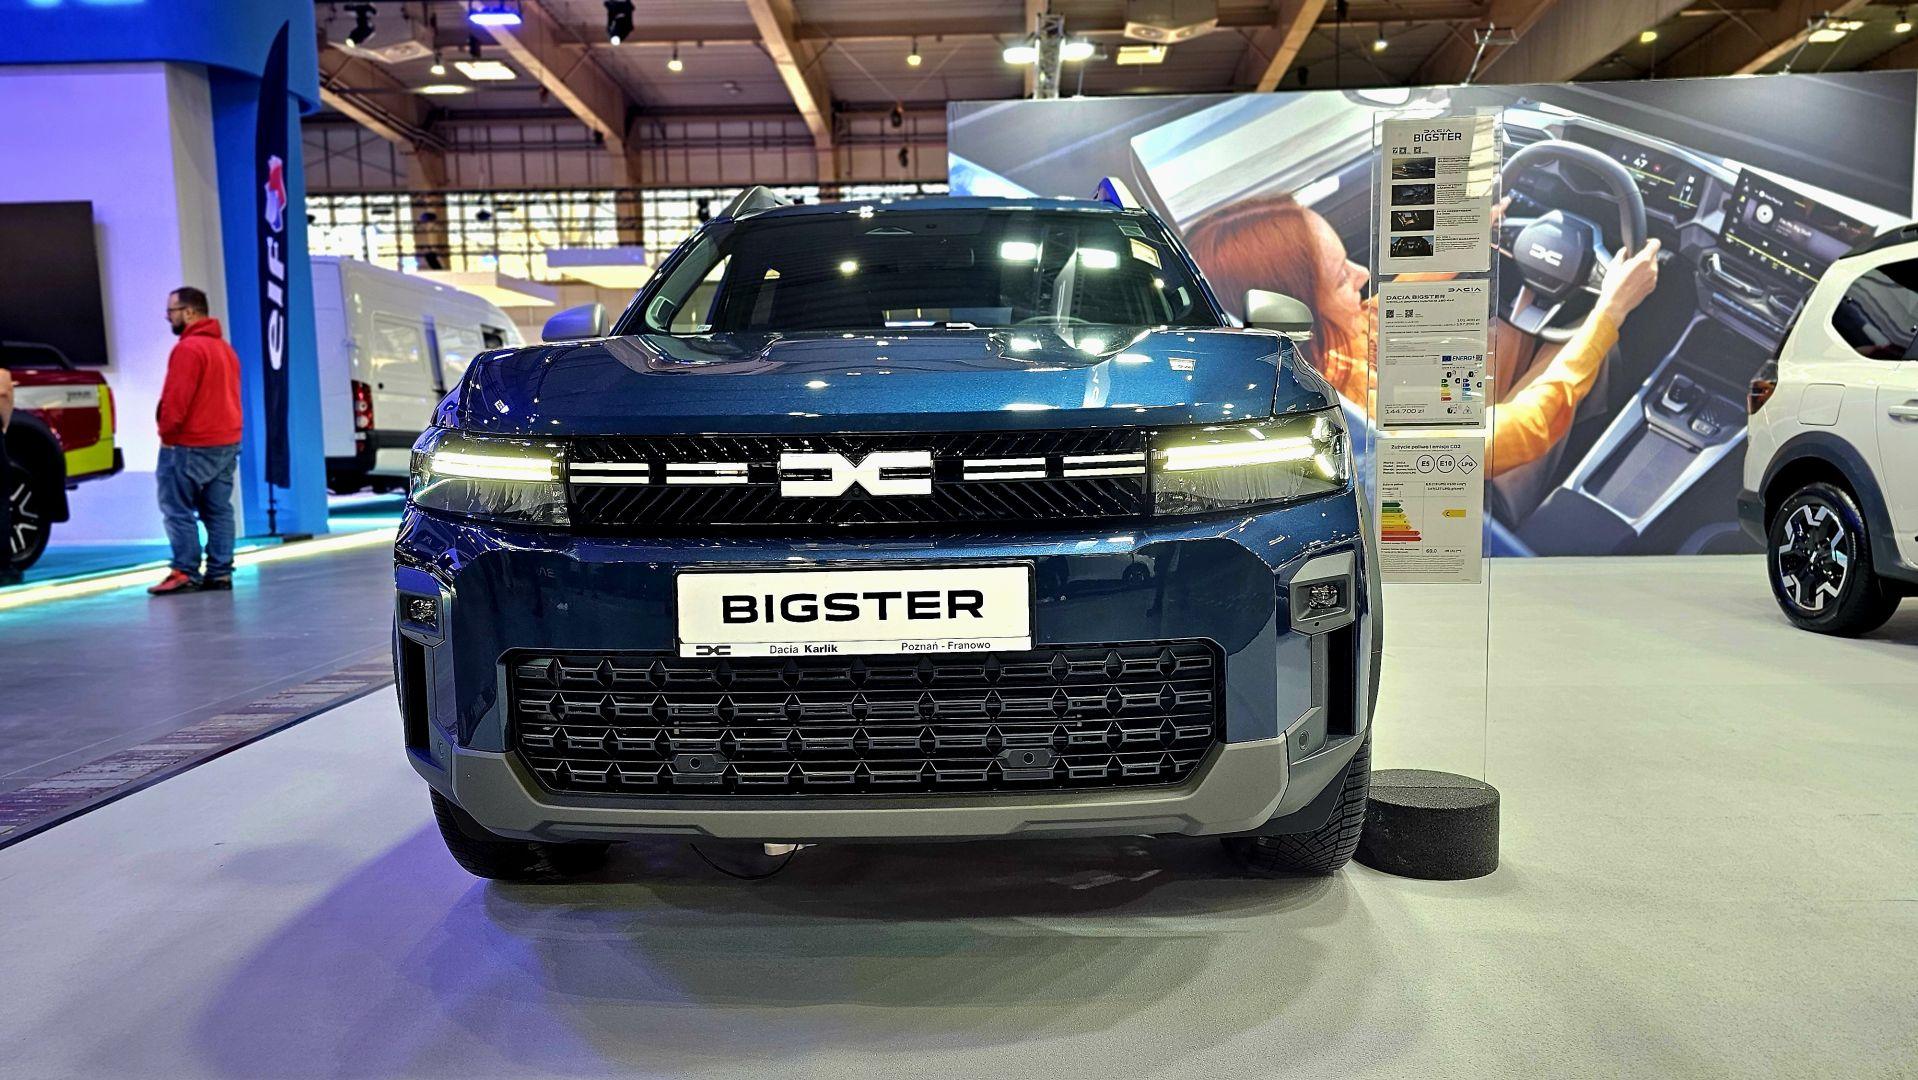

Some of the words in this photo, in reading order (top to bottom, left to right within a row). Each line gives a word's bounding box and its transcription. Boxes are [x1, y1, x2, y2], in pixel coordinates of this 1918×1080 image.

[1413, 132, 1462, 142] BIGSTER
[722, 589, 984, 624] BIGSTER
[769, 644, 799, 655] Dacia
[804, 643, 838, 654] Karlik
[901, 641, 940, 651] Poznań
[947, 640, 991, 650] Franowo
